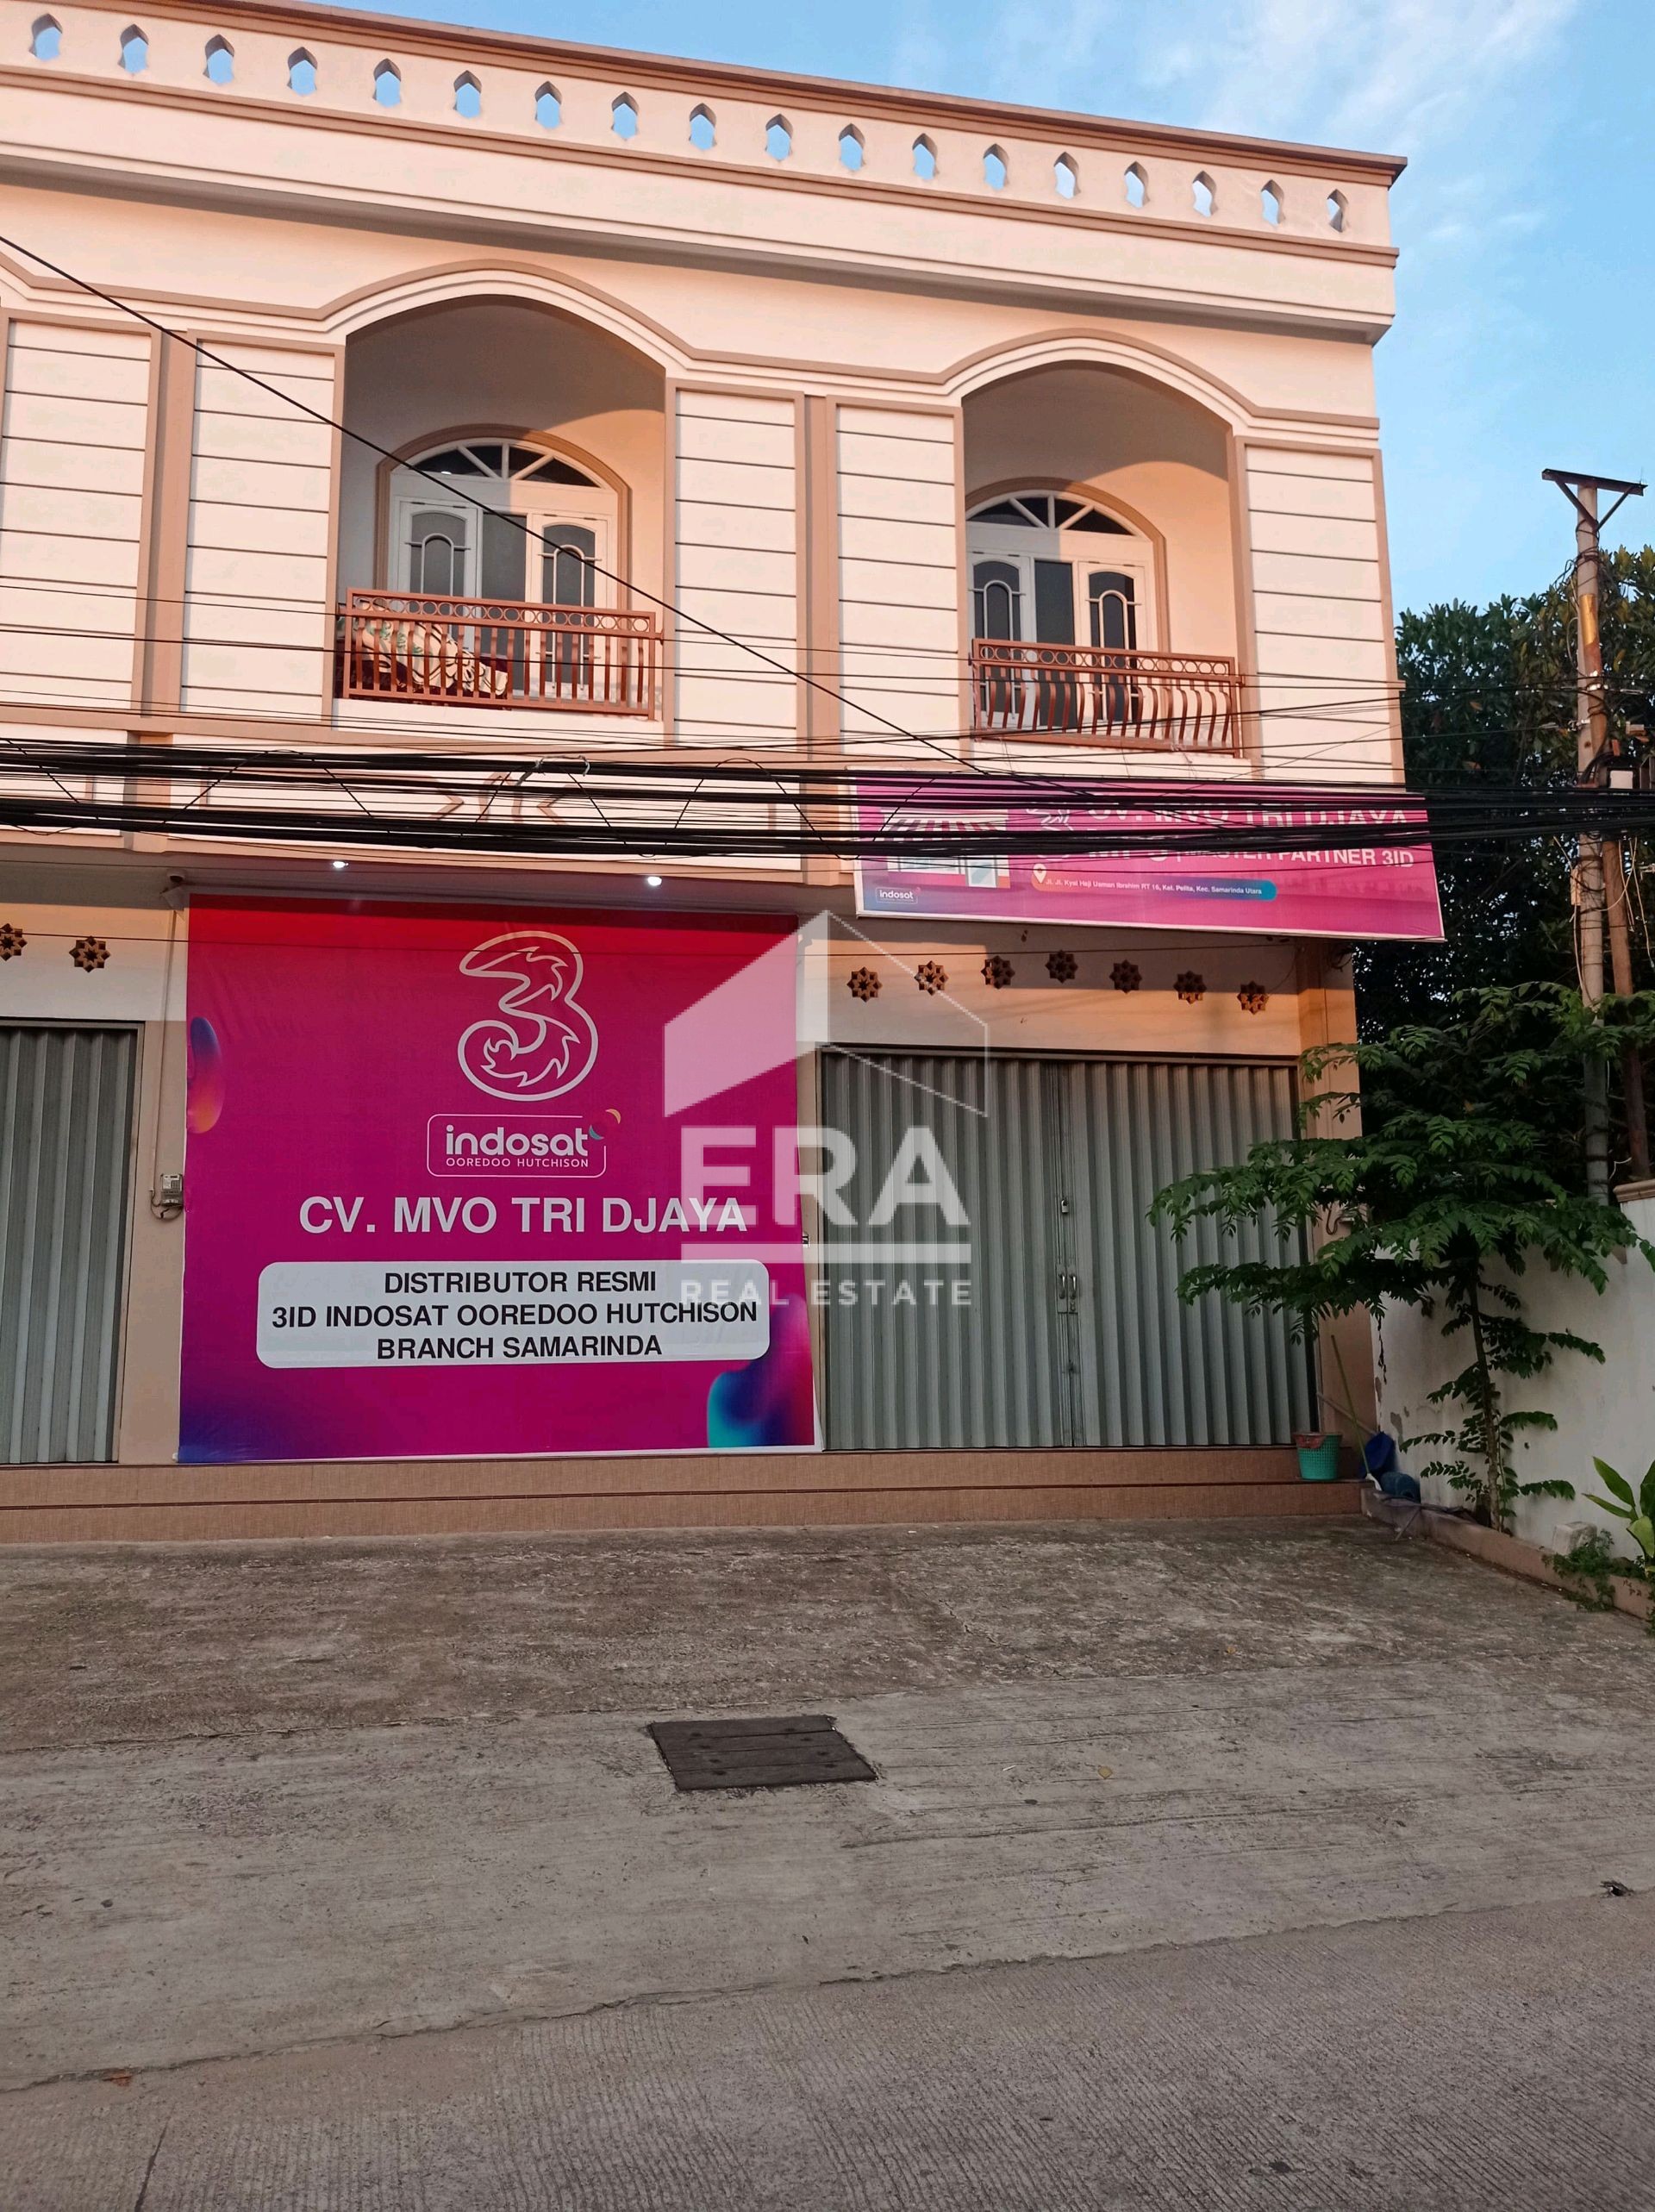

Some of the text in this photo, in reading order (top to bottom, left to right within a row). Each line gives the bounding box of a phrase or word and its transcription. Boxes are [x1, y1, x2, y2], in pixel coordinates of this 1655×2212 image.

[1279, 848, 1376, 865] PARTNER
[1382, 850, 1415, 867] 3ID
[879, 890, 914, 899] indosat
[446, 1124, 589, 1158] indosat
[446, 1158, 589, 1168] OOREDOO HUTCHISON
[298, 1196, 747, 1234] CV. MVO TRI DJAYA
[384, 1271, 656, 1295] DISTRIBUTOR RESMI
[272, 1302, 758, 1328] 3ID INDOSAT OOREDOO HUTCHISON
[378, 1334, 662, 1359] BRANCH SAMARINDA
